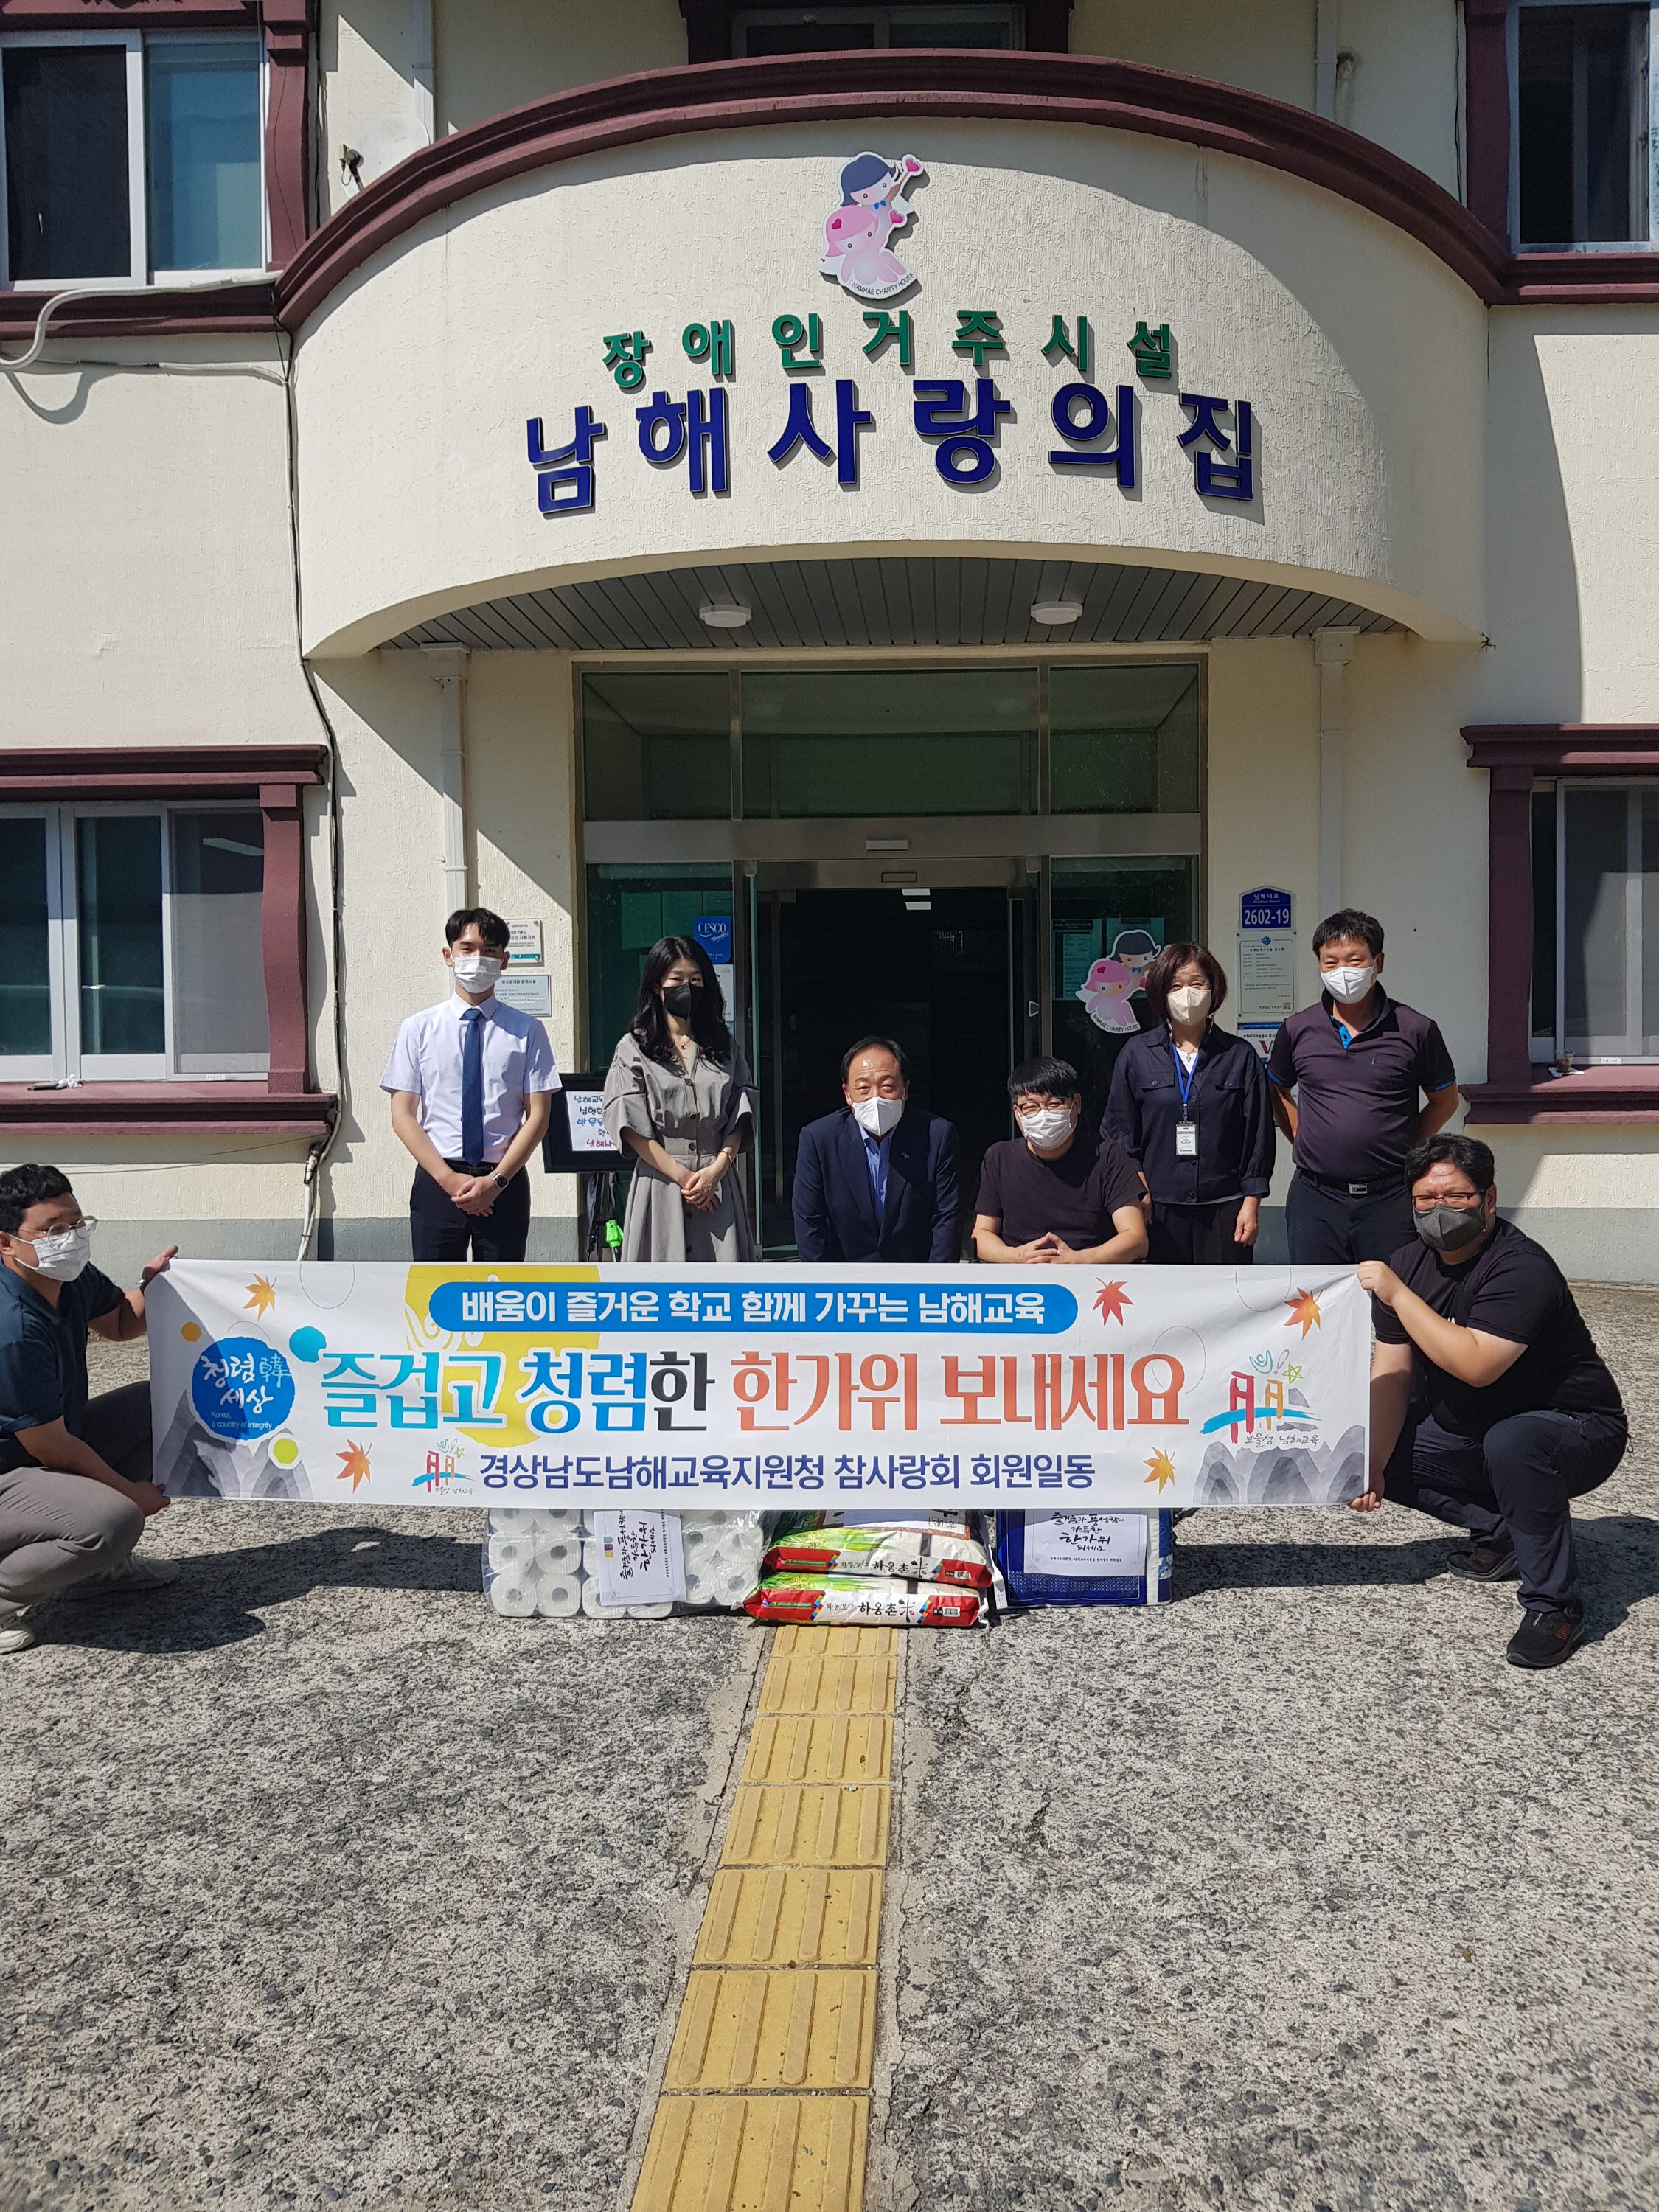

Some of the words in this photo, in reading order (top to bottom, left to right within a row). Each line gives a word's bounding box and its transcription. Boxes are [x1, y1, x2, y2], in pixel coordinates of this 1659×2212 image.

[852, 281, 874, 295] NAMHAE
[875, 284, 898, 295] CHARITY
[898, 272, 915, 287] HOUSE
[602, 310, 1173, 388] 장애인거주시설
[1244, 908, 1290, 925] 2602-19
[698, 922, 727, 933] CESCO
[1124, 1023, 1139, 1032] HOUSE
[462, 1290, 557, 1323] 배움이
[566, 1290, 659, 1323] 즐거운
[668, 1290, 731, 1323] 학교
[740, 1290, 806, 1323] 함께
[815, 1290, 908, 1323] 가꾸는
[919, 1290, 1045, 1324] 남해교육
[220, 1385, 274, 1414] 세상
[322, 1352, 506, 1429] 즐겁고
[521, 1351, 715, 1433] 청렴한
[731, 1352, 918, 1431] 한가위
[940, 1352, 1189, 1431] 보내세요
[211, 1411, 232, 1419] Korea,
[217, 1422, 240, 1430] country
[248, 1421, 273, 1430] integrity
[1279, 1433, 1320, 1447] 남해교육
[480, 1454, 824, 1489] 경상남도남해교육지원청
[834, 1454, 960, 1489] 참사랑회
[970, 1454, 1095, 1489] 회원일동
